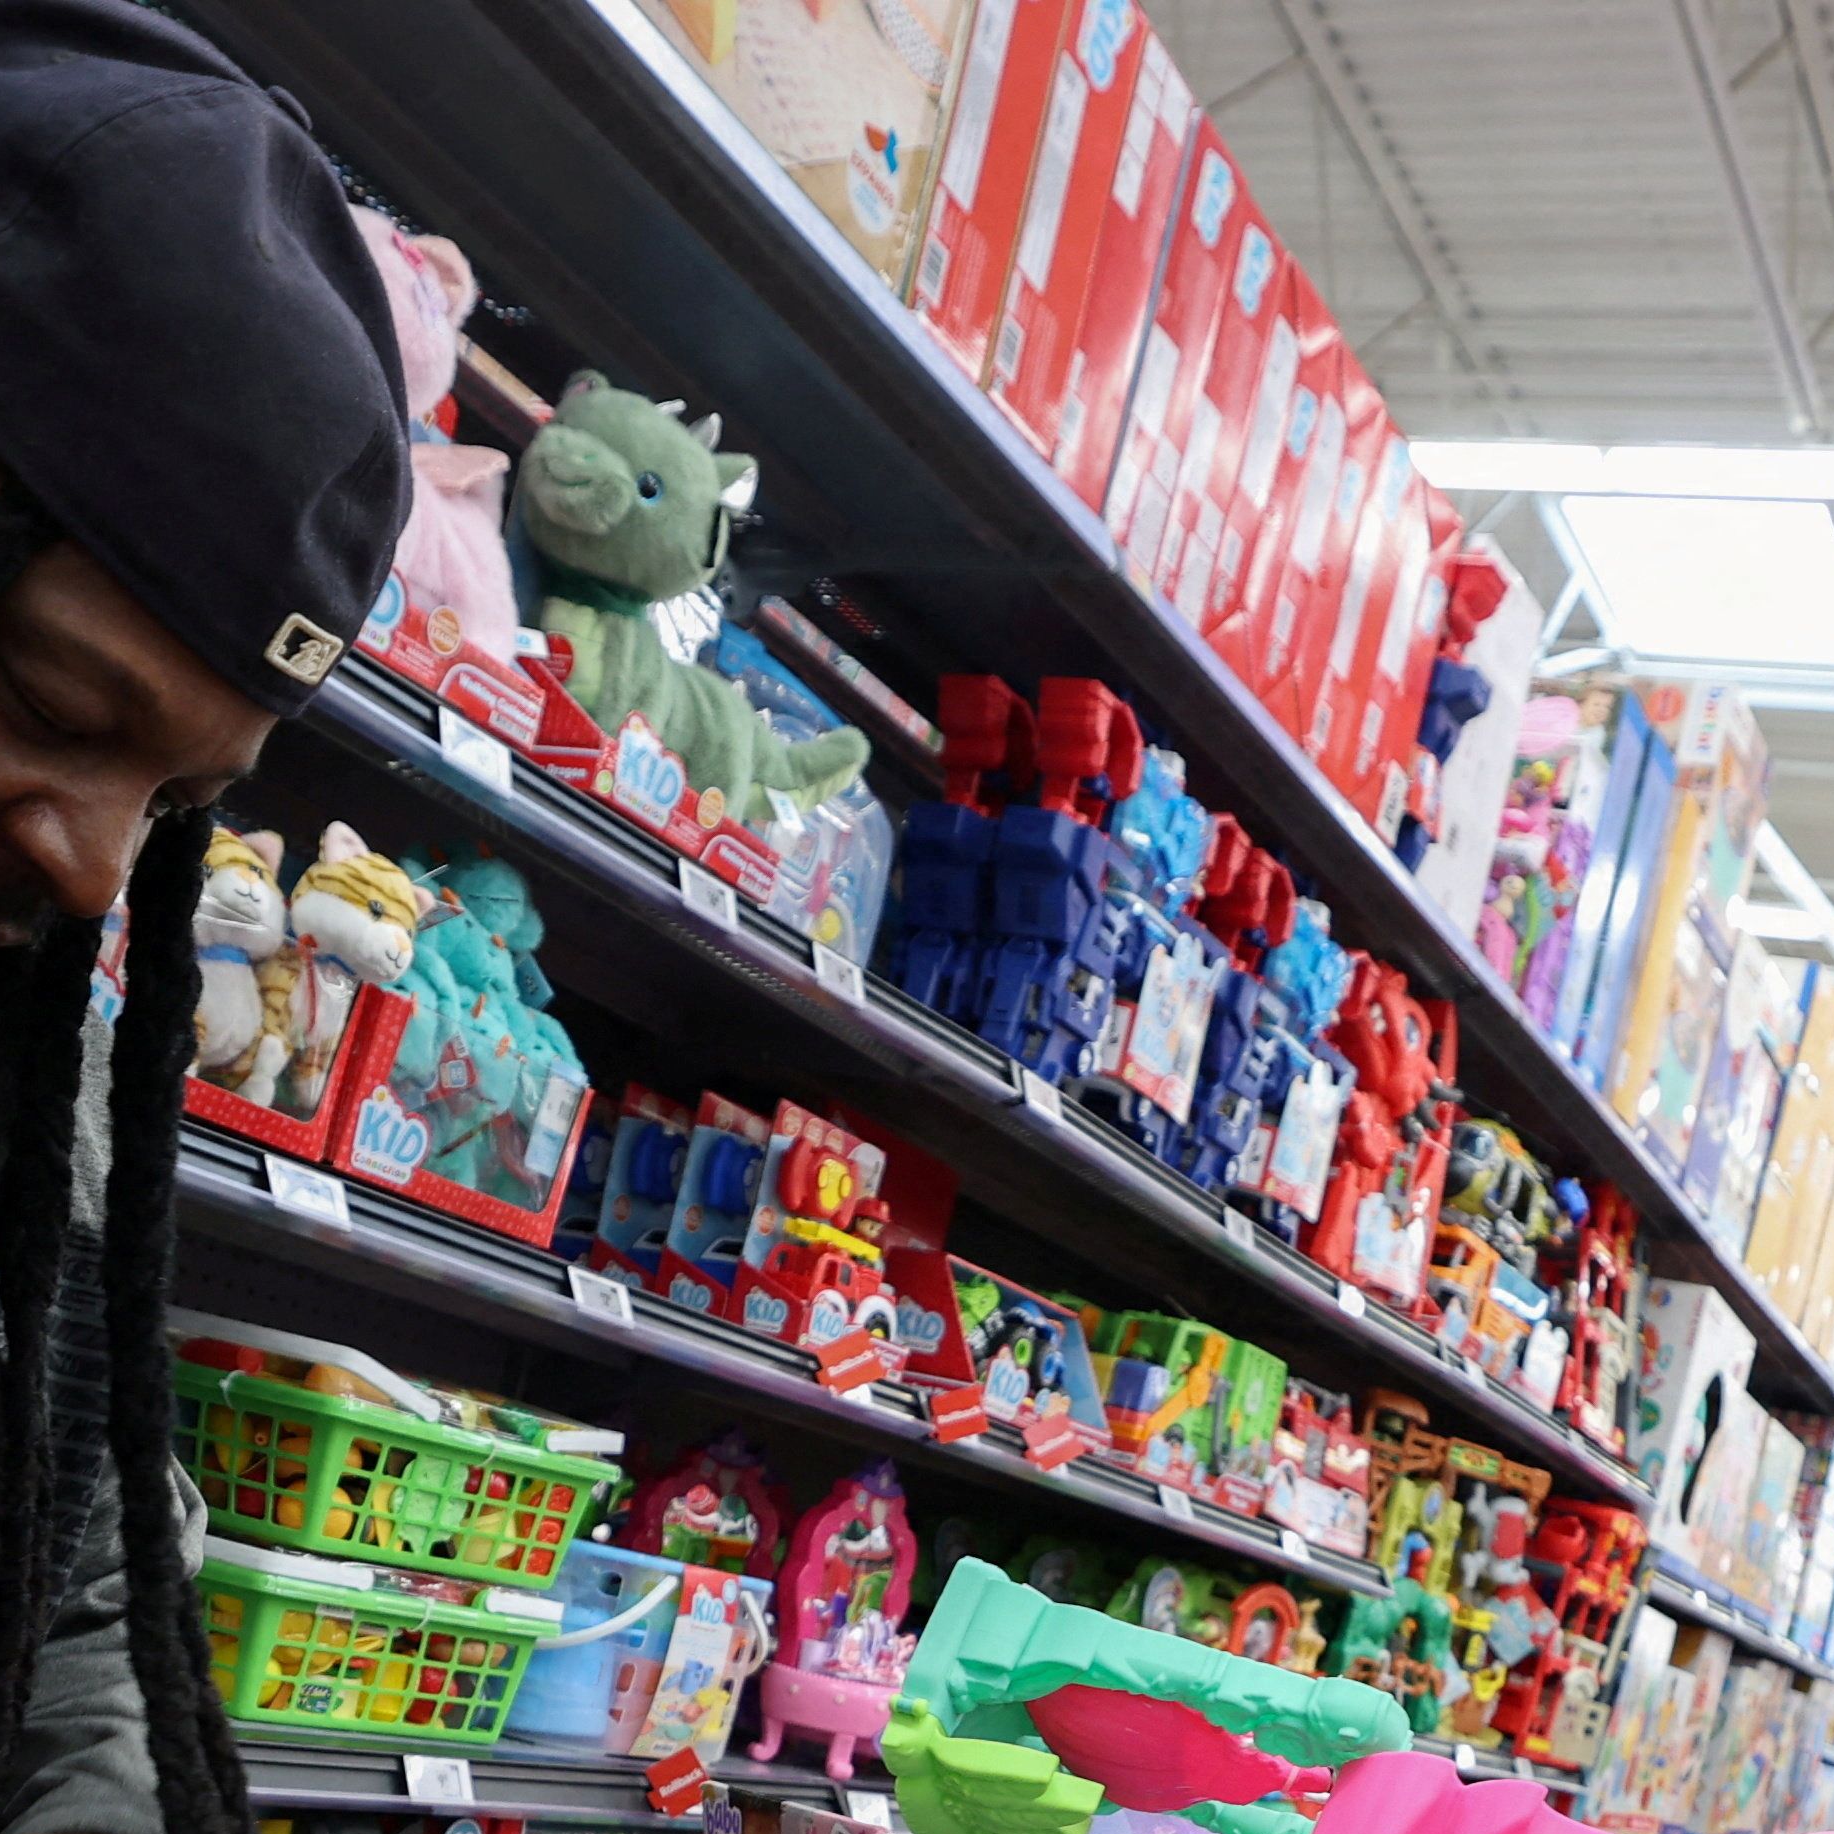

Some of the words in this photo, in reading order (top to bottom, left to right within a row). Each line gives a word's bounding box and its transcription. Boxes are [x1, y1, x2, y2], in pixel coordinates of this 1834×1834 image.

[619, 733, 680, 806] KID
[359, 1103, 424, 1164] KID
[354, 1151, 408, 1181] Connection
[746, 1293, 789, 1324] KID
[812, 1306, 844, 1341] KID
[896, 1307, 945, 1344] KID
[987, 1361, 1029, 1404] KID
[693, 1597, 725, 1625] KID
[659, 1768, 704, 1799] Rollback
